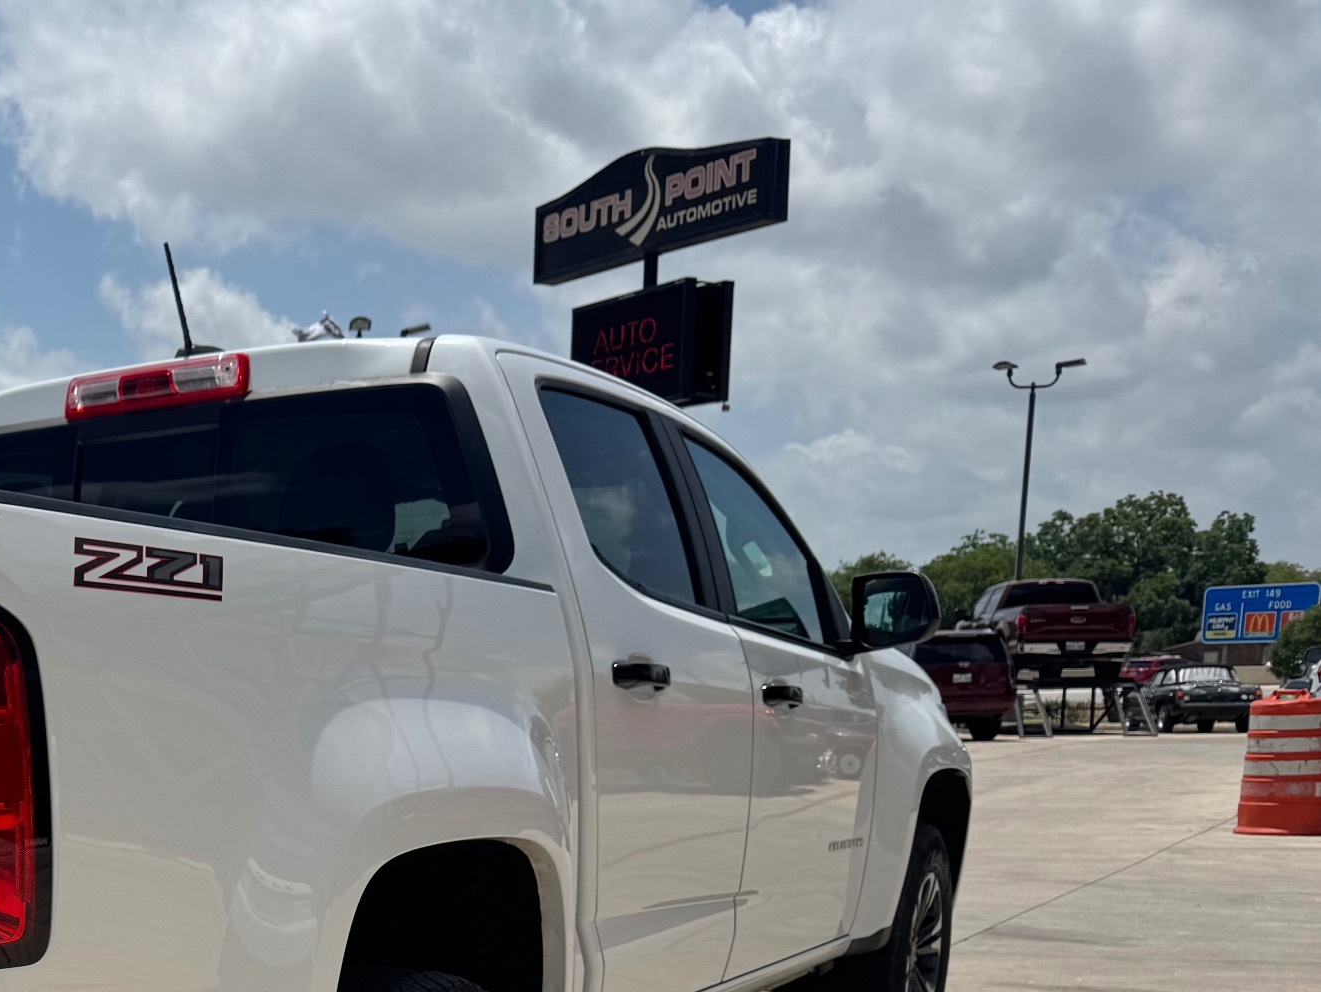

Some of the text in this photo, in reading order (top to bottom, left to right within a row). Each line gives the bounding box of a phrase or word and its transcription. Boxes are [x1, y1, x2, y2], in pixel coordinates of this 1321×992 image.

[542, 148, 757, 244] SOUTH POINT
[656, 188, 758, 233] AUTOMOTIVE
[593, 317, 657, 355] AUTO
[73, 536, 223, 602] Z71
[1214, 602, 1231, 611] GAS
[1242, 588, 1281, 599] EXIT 149
[1268, 600, 1292, 609] FOOD
